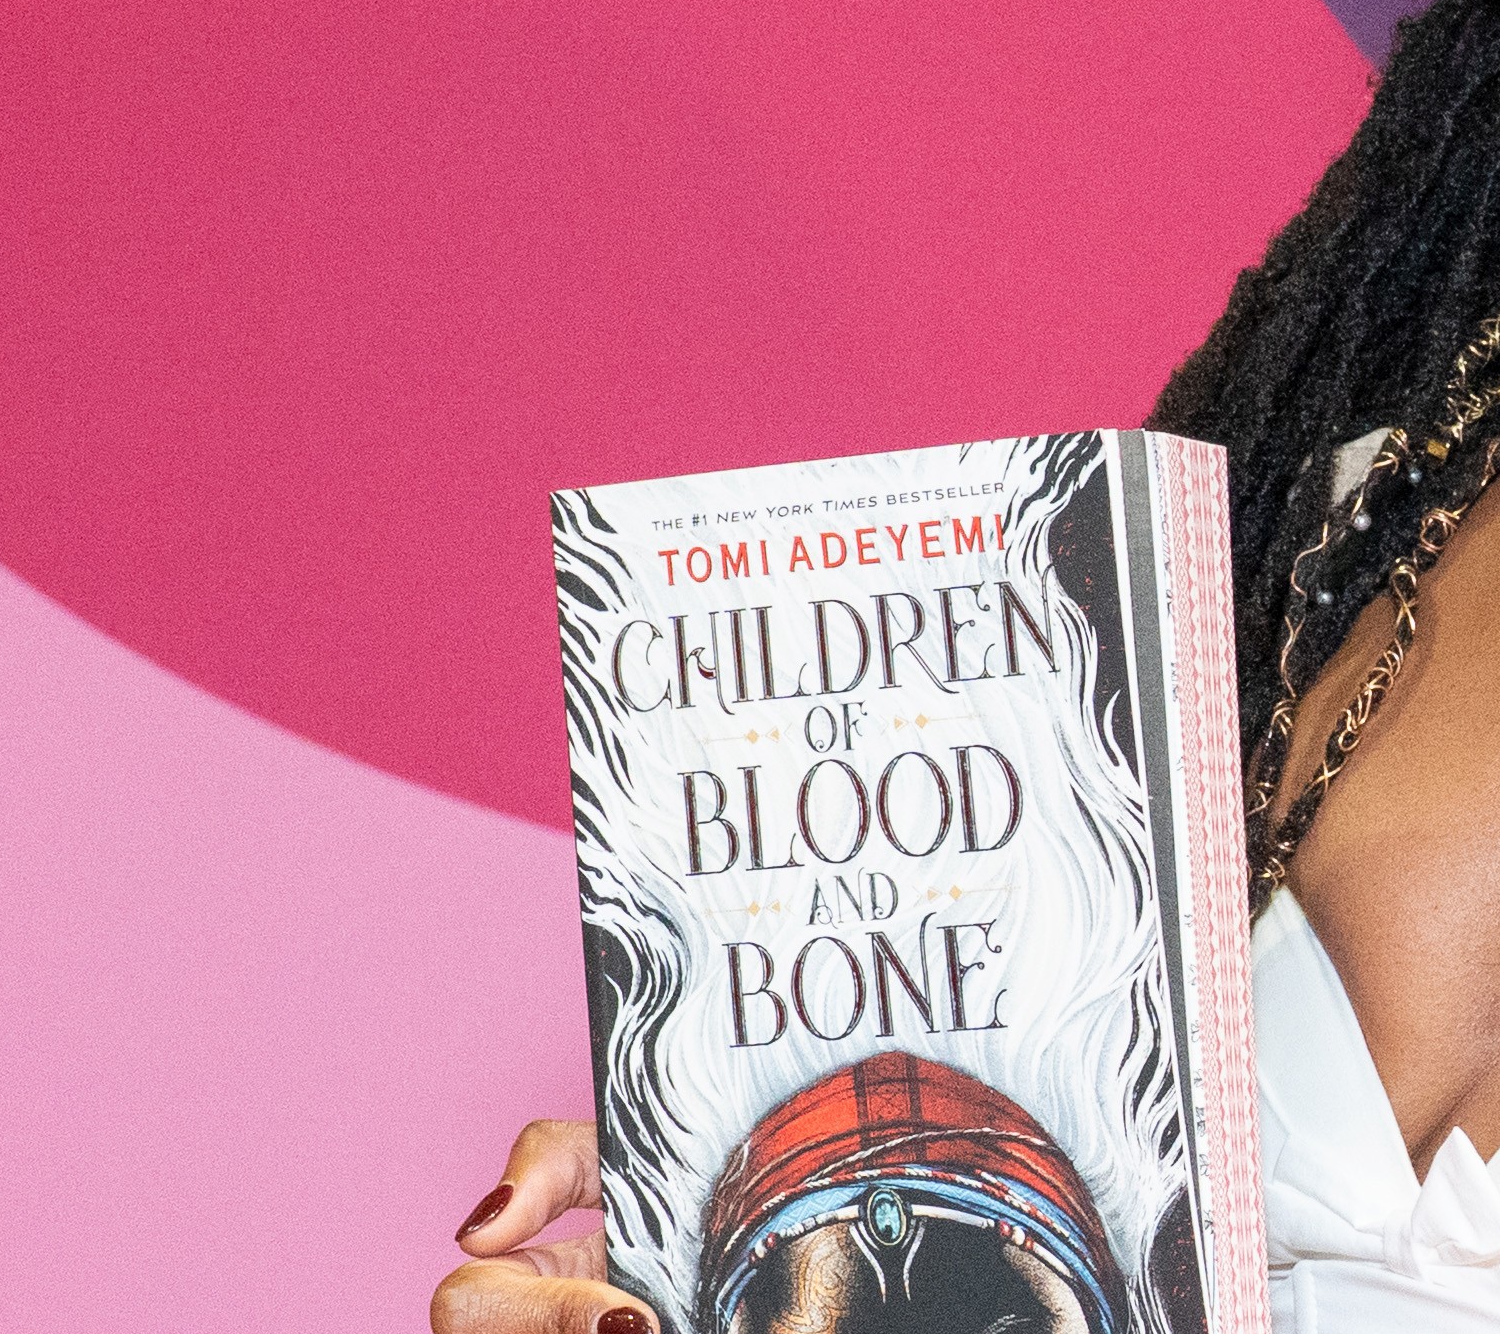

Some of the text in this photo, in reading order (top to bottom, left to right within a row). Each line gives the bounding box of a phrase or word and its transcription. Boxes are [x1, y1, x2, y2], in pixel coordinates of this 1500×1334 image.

[652, 482, 1005, 531] THE #1 NEW YORK TIMES BESTSELLER
[658, 514, 1006, 586] TOMI ADEYEMI
[611, 564, 1062, 715] CHILDREN
[803, 700, 868, 753] OF
[678, 745, 1023, 876] BLOOD
[806, 867, 899, 928] AND
[721, 912, 1008, 1048] BONE
